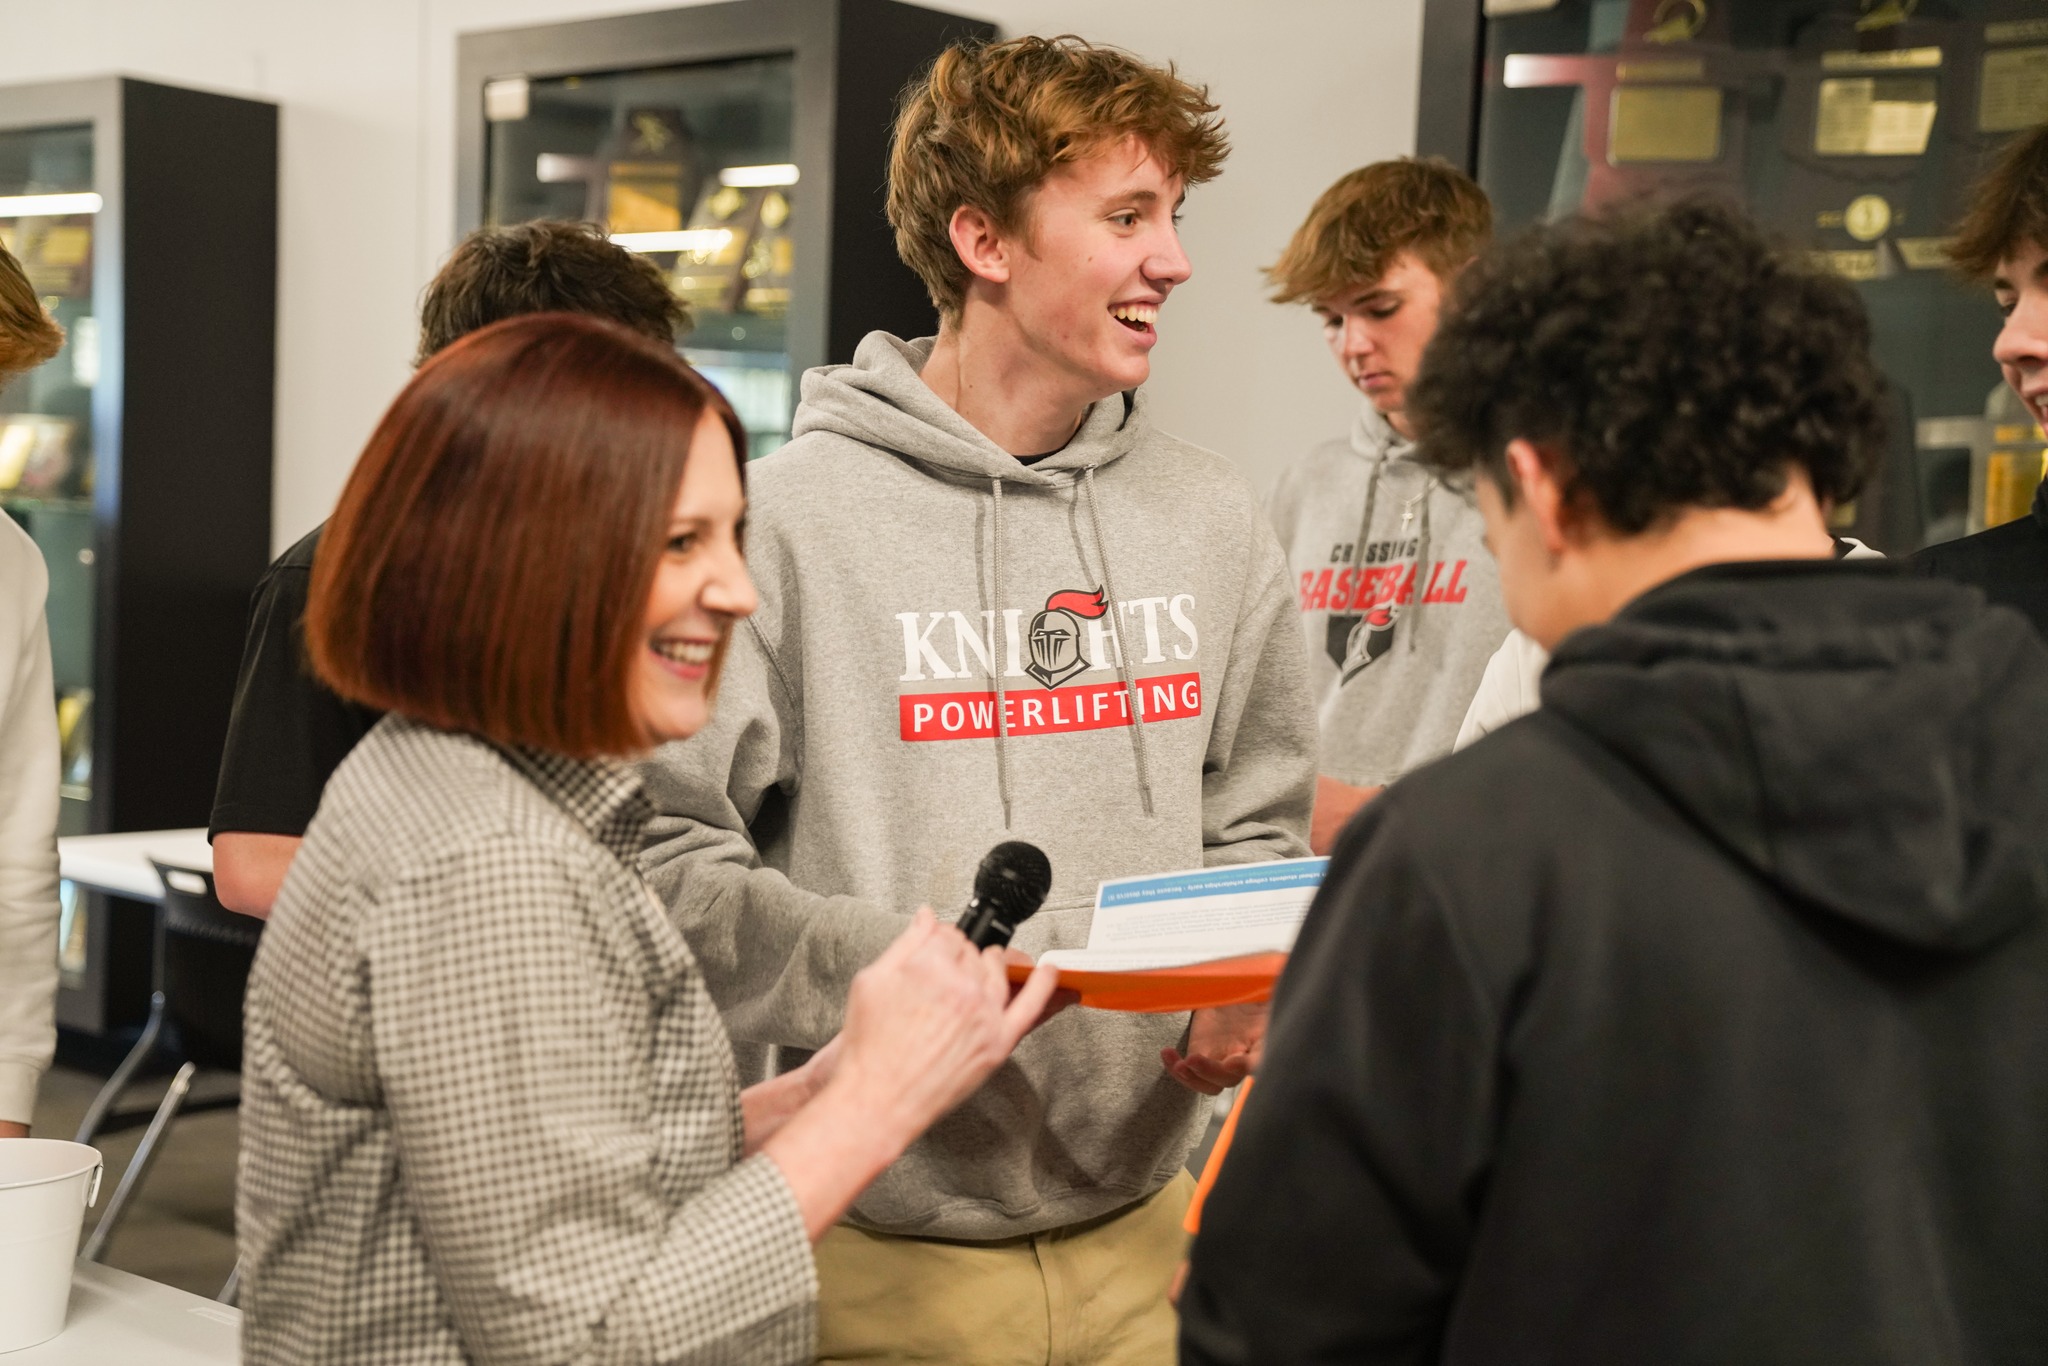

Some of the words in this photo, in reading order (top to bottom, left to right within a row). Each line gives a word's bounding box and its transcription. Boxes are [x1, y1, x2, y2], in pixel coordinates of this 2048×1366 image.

[1300, 560, 1468, 611] BASEBALL
[895, 593, 1199, 681] KNIHTS
[913, 681, 1199, 733] POWERLIFTING
